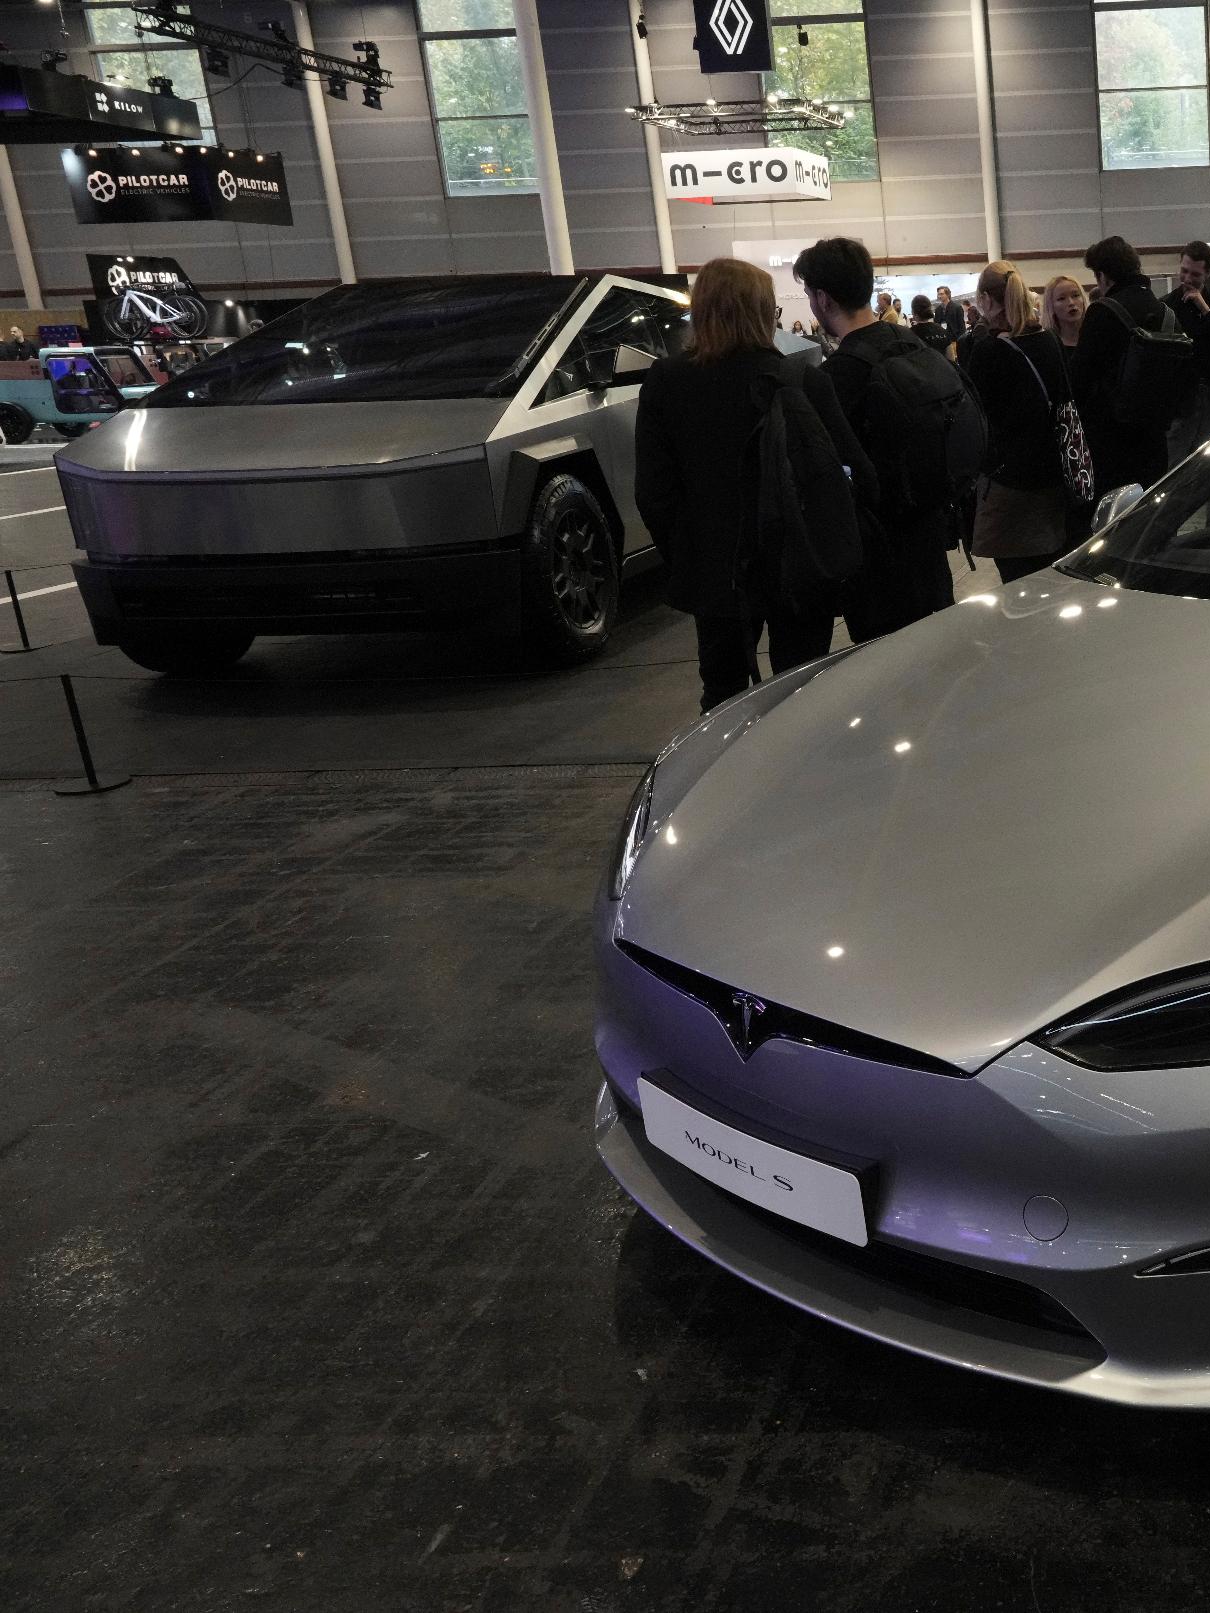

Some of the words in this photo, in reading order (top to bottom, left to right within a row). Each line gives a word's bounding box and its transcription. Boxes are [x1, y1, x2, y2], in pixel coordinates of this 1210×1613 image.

[114, 100, 143, 113] KILOW
[118, 174, 189, 187] PILOTCAR
[236, 177, 279, 193] PILOTCAR
[129, 271, 179, 284] PILOTCAR
[685, 1130, 766, 1182] MODEL
[773, 1174, 794, 1192] S
